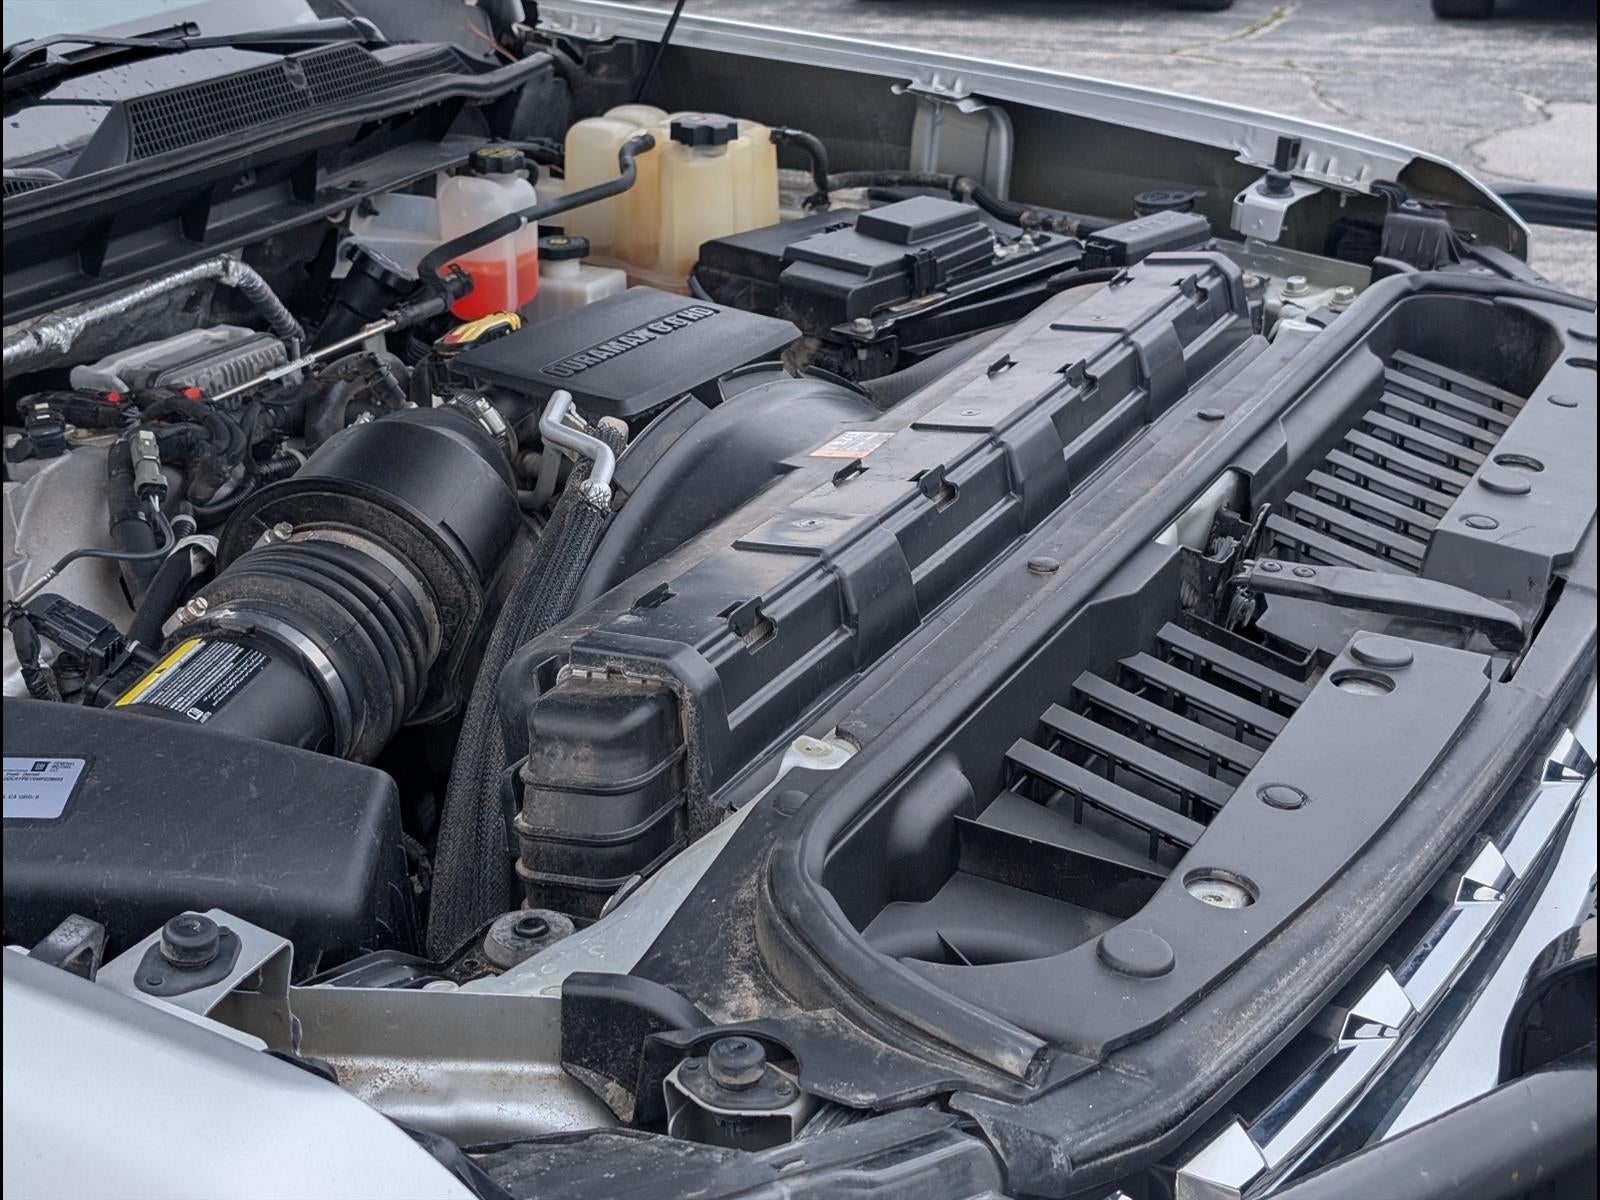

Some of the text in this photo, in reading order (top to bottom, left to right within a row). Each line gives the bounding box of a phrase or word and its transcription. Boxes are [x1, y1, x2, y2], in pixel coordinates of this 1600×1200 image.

[545, 306, 717, 378] DURAMAX 6.6 HD
